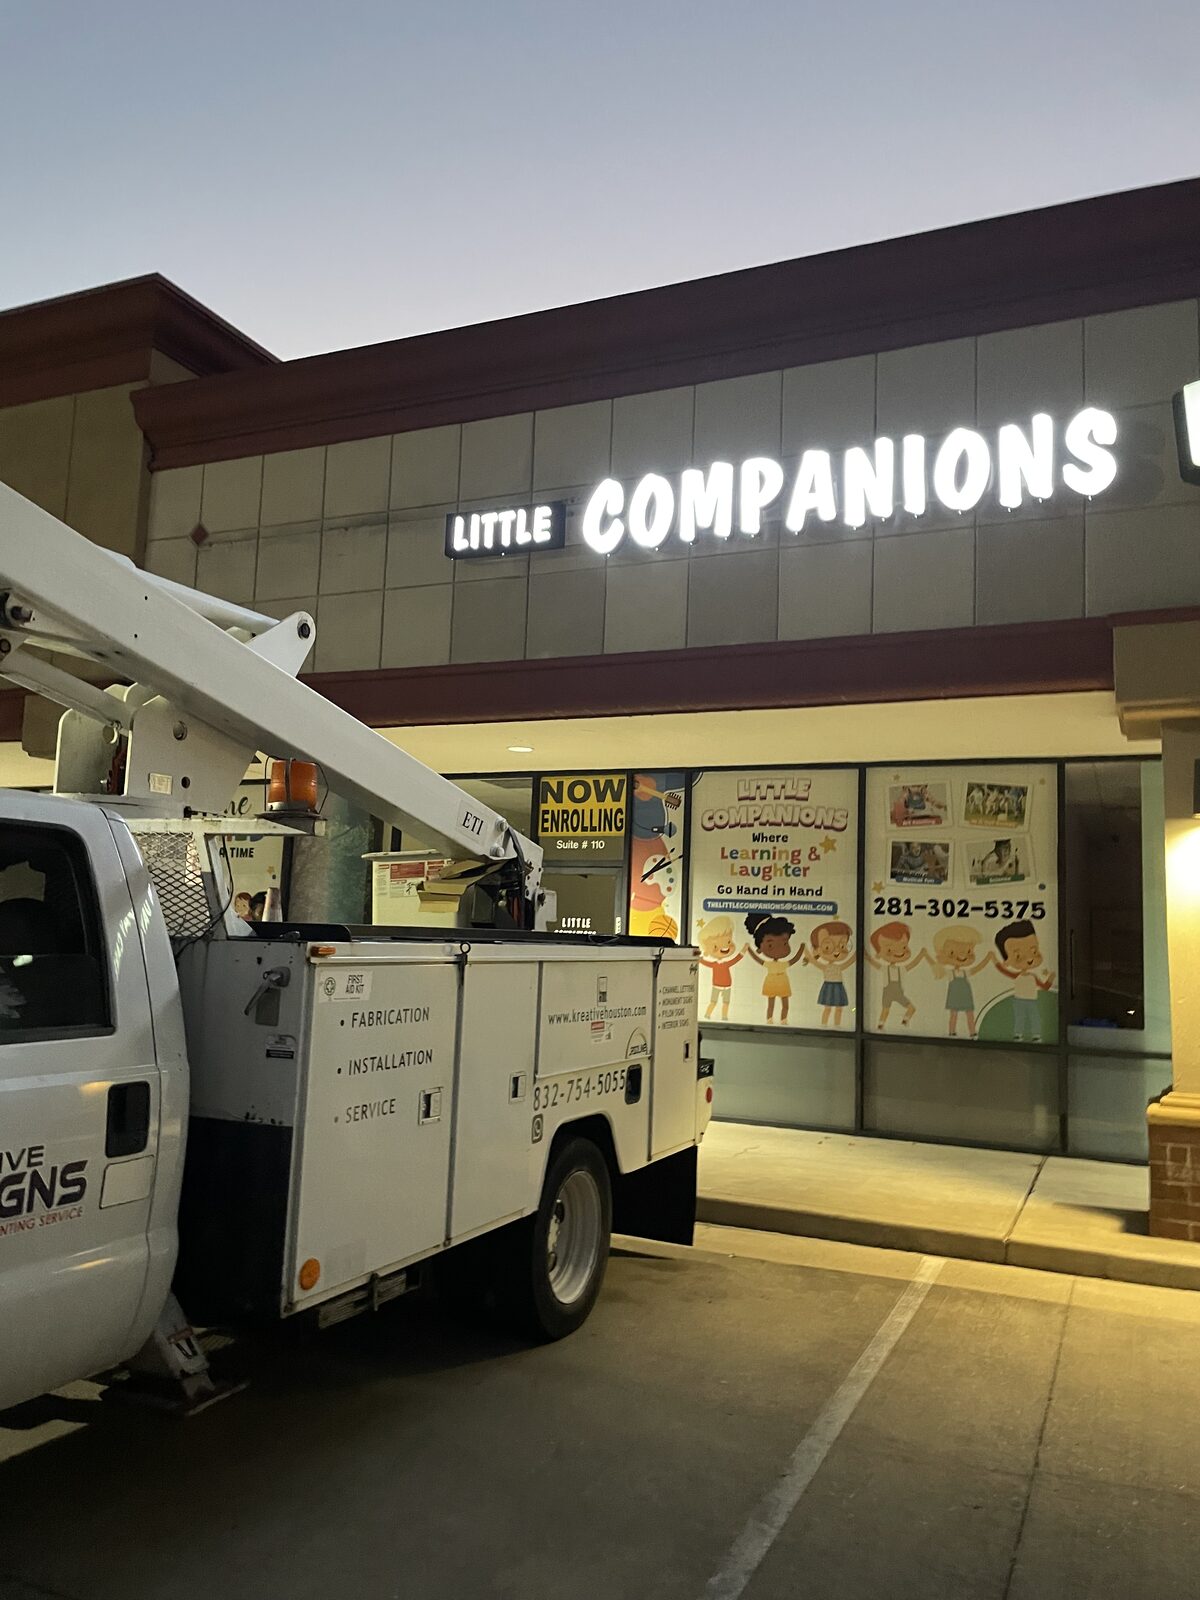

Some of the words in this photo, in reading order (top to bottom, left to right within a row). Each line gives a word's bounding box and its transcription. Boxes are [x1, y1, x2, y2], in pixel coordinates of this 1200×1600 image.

[453, 505, 552, 551] LITTLE
[581, 406, 1117, 554] COMPANIONS
[541, 778, 625, 804] NOW
[737, 778, 811, 801] LITTLE
[462, 811, 483, 835] ETI
[541, 808, 624, 832] ENROLLING
[701, 804, 848, 832] COMPANIONS
[556, 840, 578, 849] Suite
[582, 840, 588, 849] #
[591, 840, 605, 849] 110
[752, 832, 789, 843] Where
[230, 847, 254, 858] TIME
[720, 847, 801, 865] Learning
[808, 847, 820, 861] &
[730, 863, 810, 881] Laughter
[717, 885, 732, 895] Go
[736, 885, 768, 896] Hand
[773, 885, 785, 896] in
[789, 886, 823, 896] Hand
[707, 901, 833, 912] THELITTLECOMPANIONS@GMAIL.COM
[874, 897, 1046, 919] 281-302-5375
[561, 917, 591, 928] LITTLE
[345, 985, 355, 994] AID
[356, 984, 364, 994] KIT
[348, 974, 364, 984] FIRST
[351, 1007, 430, 1029] FABRICATION
[548, 1006, 647, 1024] www.kreativehouston.com
[348, 1049, 433, 1076] INSTALLATION
[533, 1069, 626, 1111] 832-754-5055
[345, 1098, 396, 1123] SERVICE
[39, 1206, 83, 1226] SERVICE
